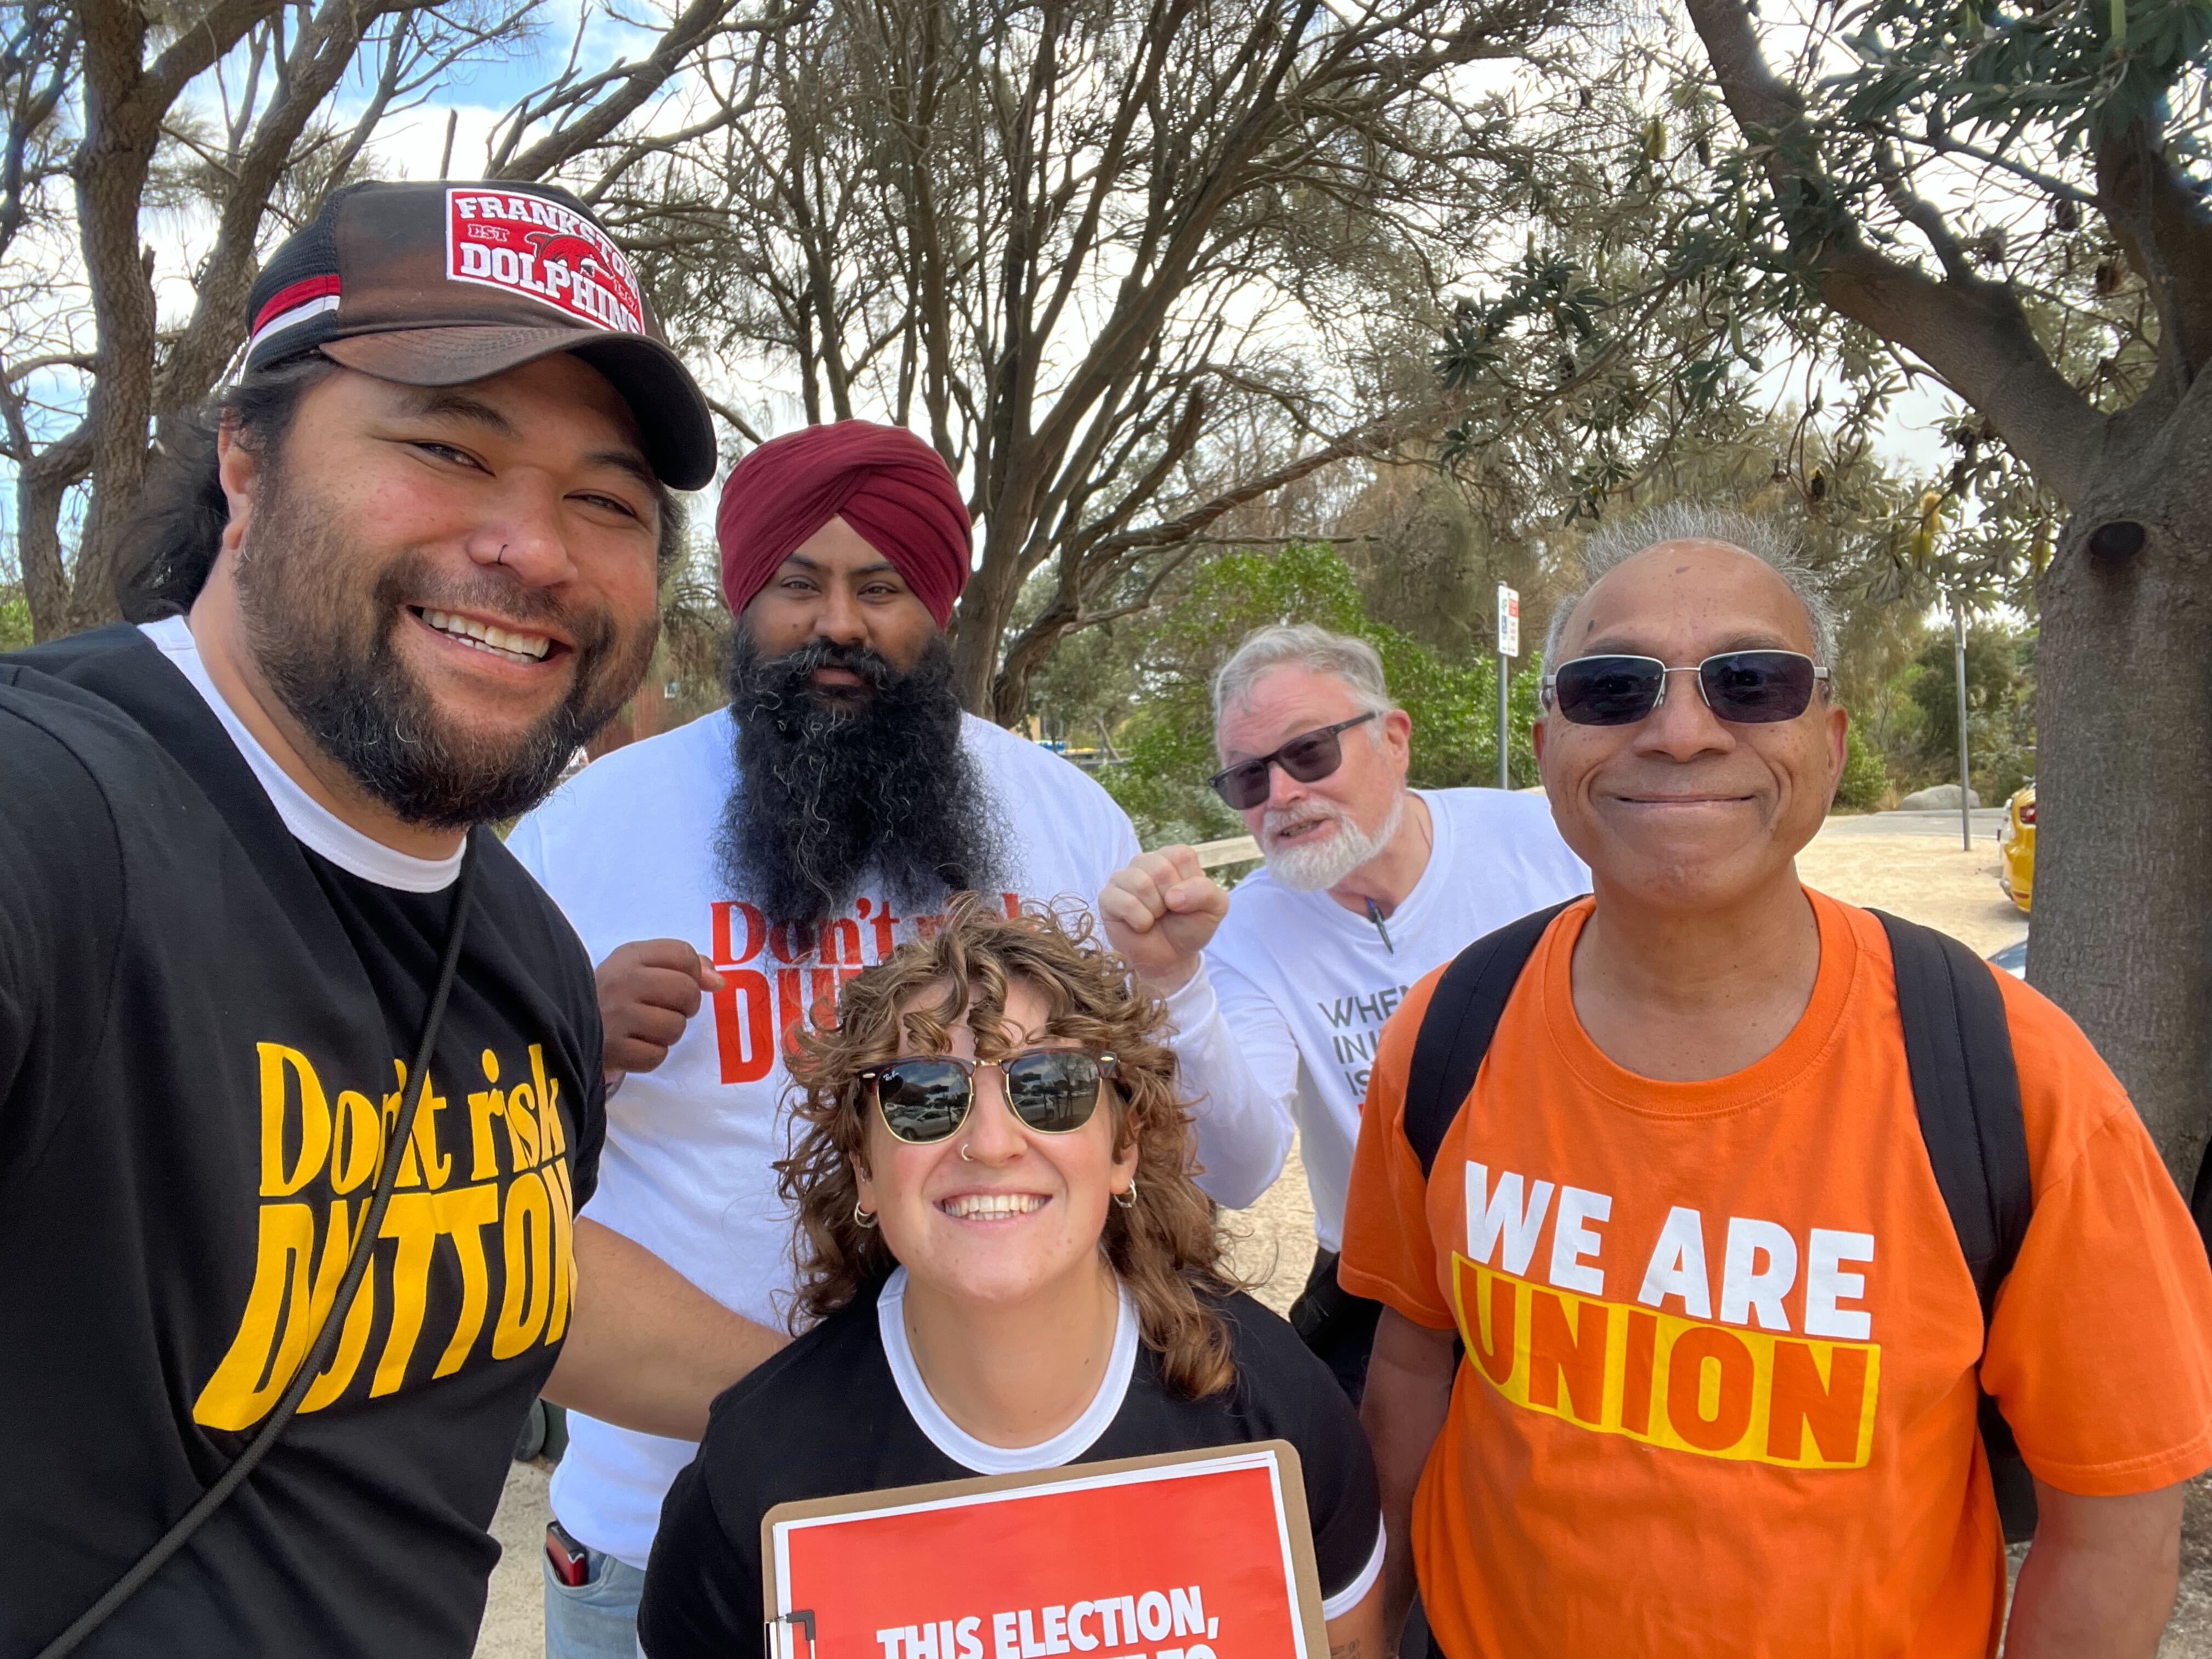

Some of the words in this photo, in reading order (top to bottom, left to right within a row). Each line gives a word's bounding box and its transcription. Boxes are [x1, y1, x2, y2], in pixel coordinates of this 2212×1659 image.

[454, 196, 637, 300] FRANKSTON
[460, 242, 641, 334] DOLPHINS
[468, 223, 510, 242] EST
[256, 1042, 451, 1197] Don't
[467, 1042, 566, 1182] risk
[193, 1156, 578, 1431] DUTTON
[1465, 1160, 1612, 1296] WE
[1637, 1206, 1875, 1340] ARE
[1458, 1259, 1869, 1464] UNION
[876, 1616, 984, 1659] THIS
[992, 1585, 1220, 1659] ELECTION,
